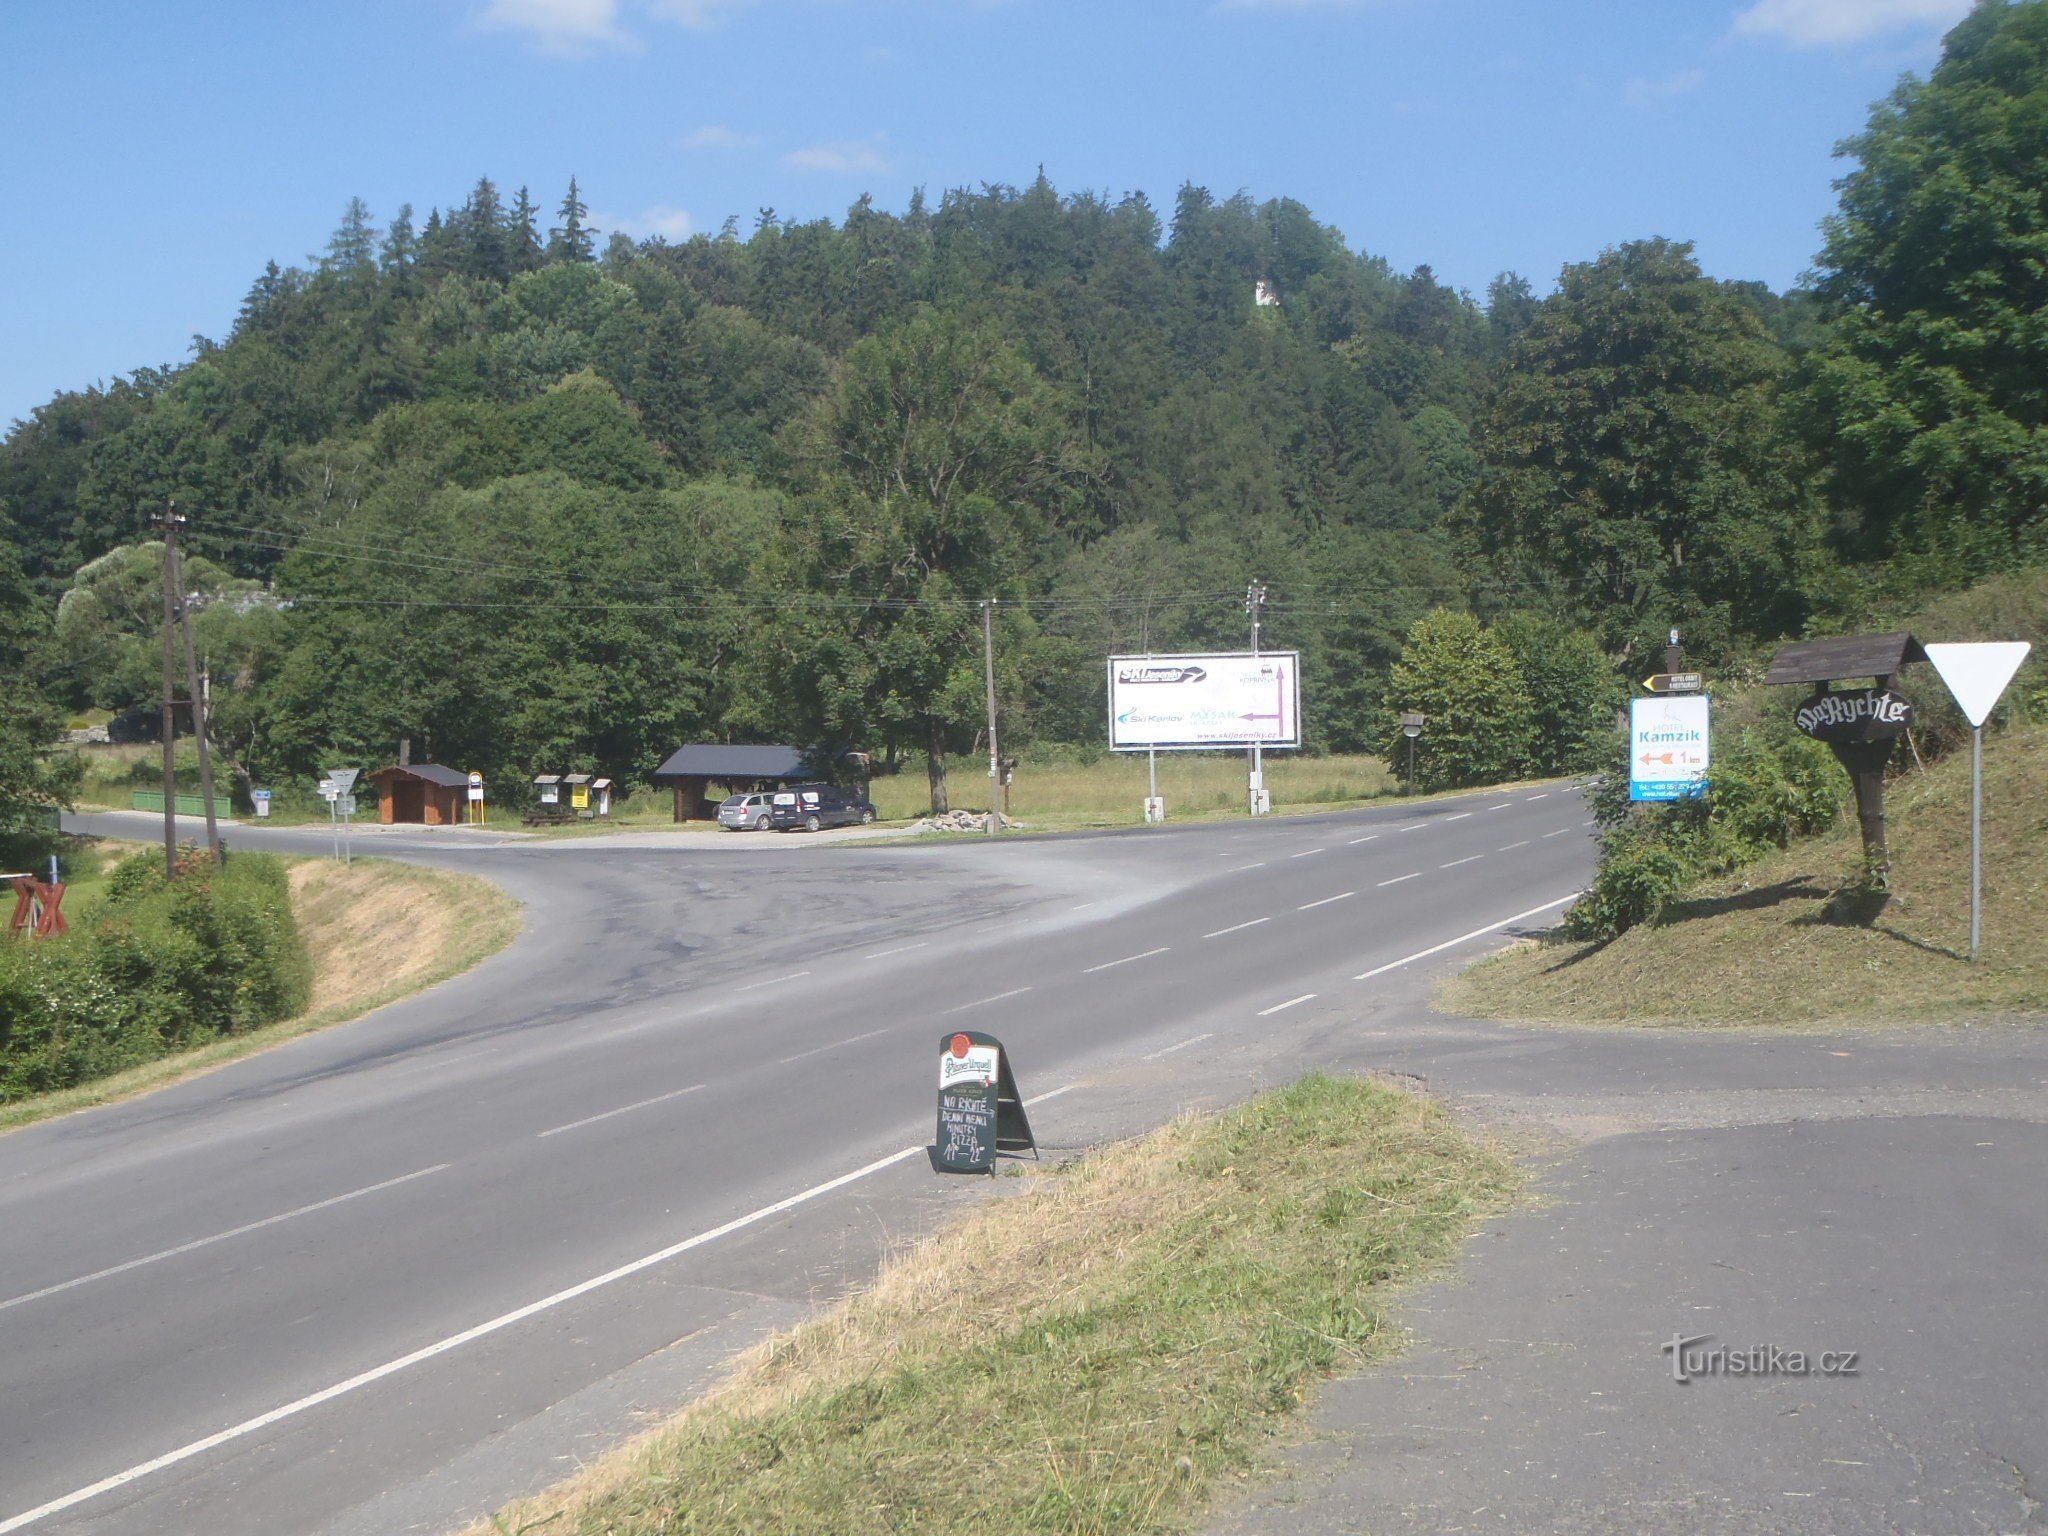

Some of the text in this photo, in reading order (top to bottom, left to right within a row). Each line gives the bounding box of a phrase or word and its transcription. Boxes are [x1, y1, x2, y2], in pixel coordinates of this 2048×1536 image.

[1680, 751, 1687, 763] 1
[944, 1095, 956, 1108] NA
[951, 1133, 978, 1148] PIZZA
